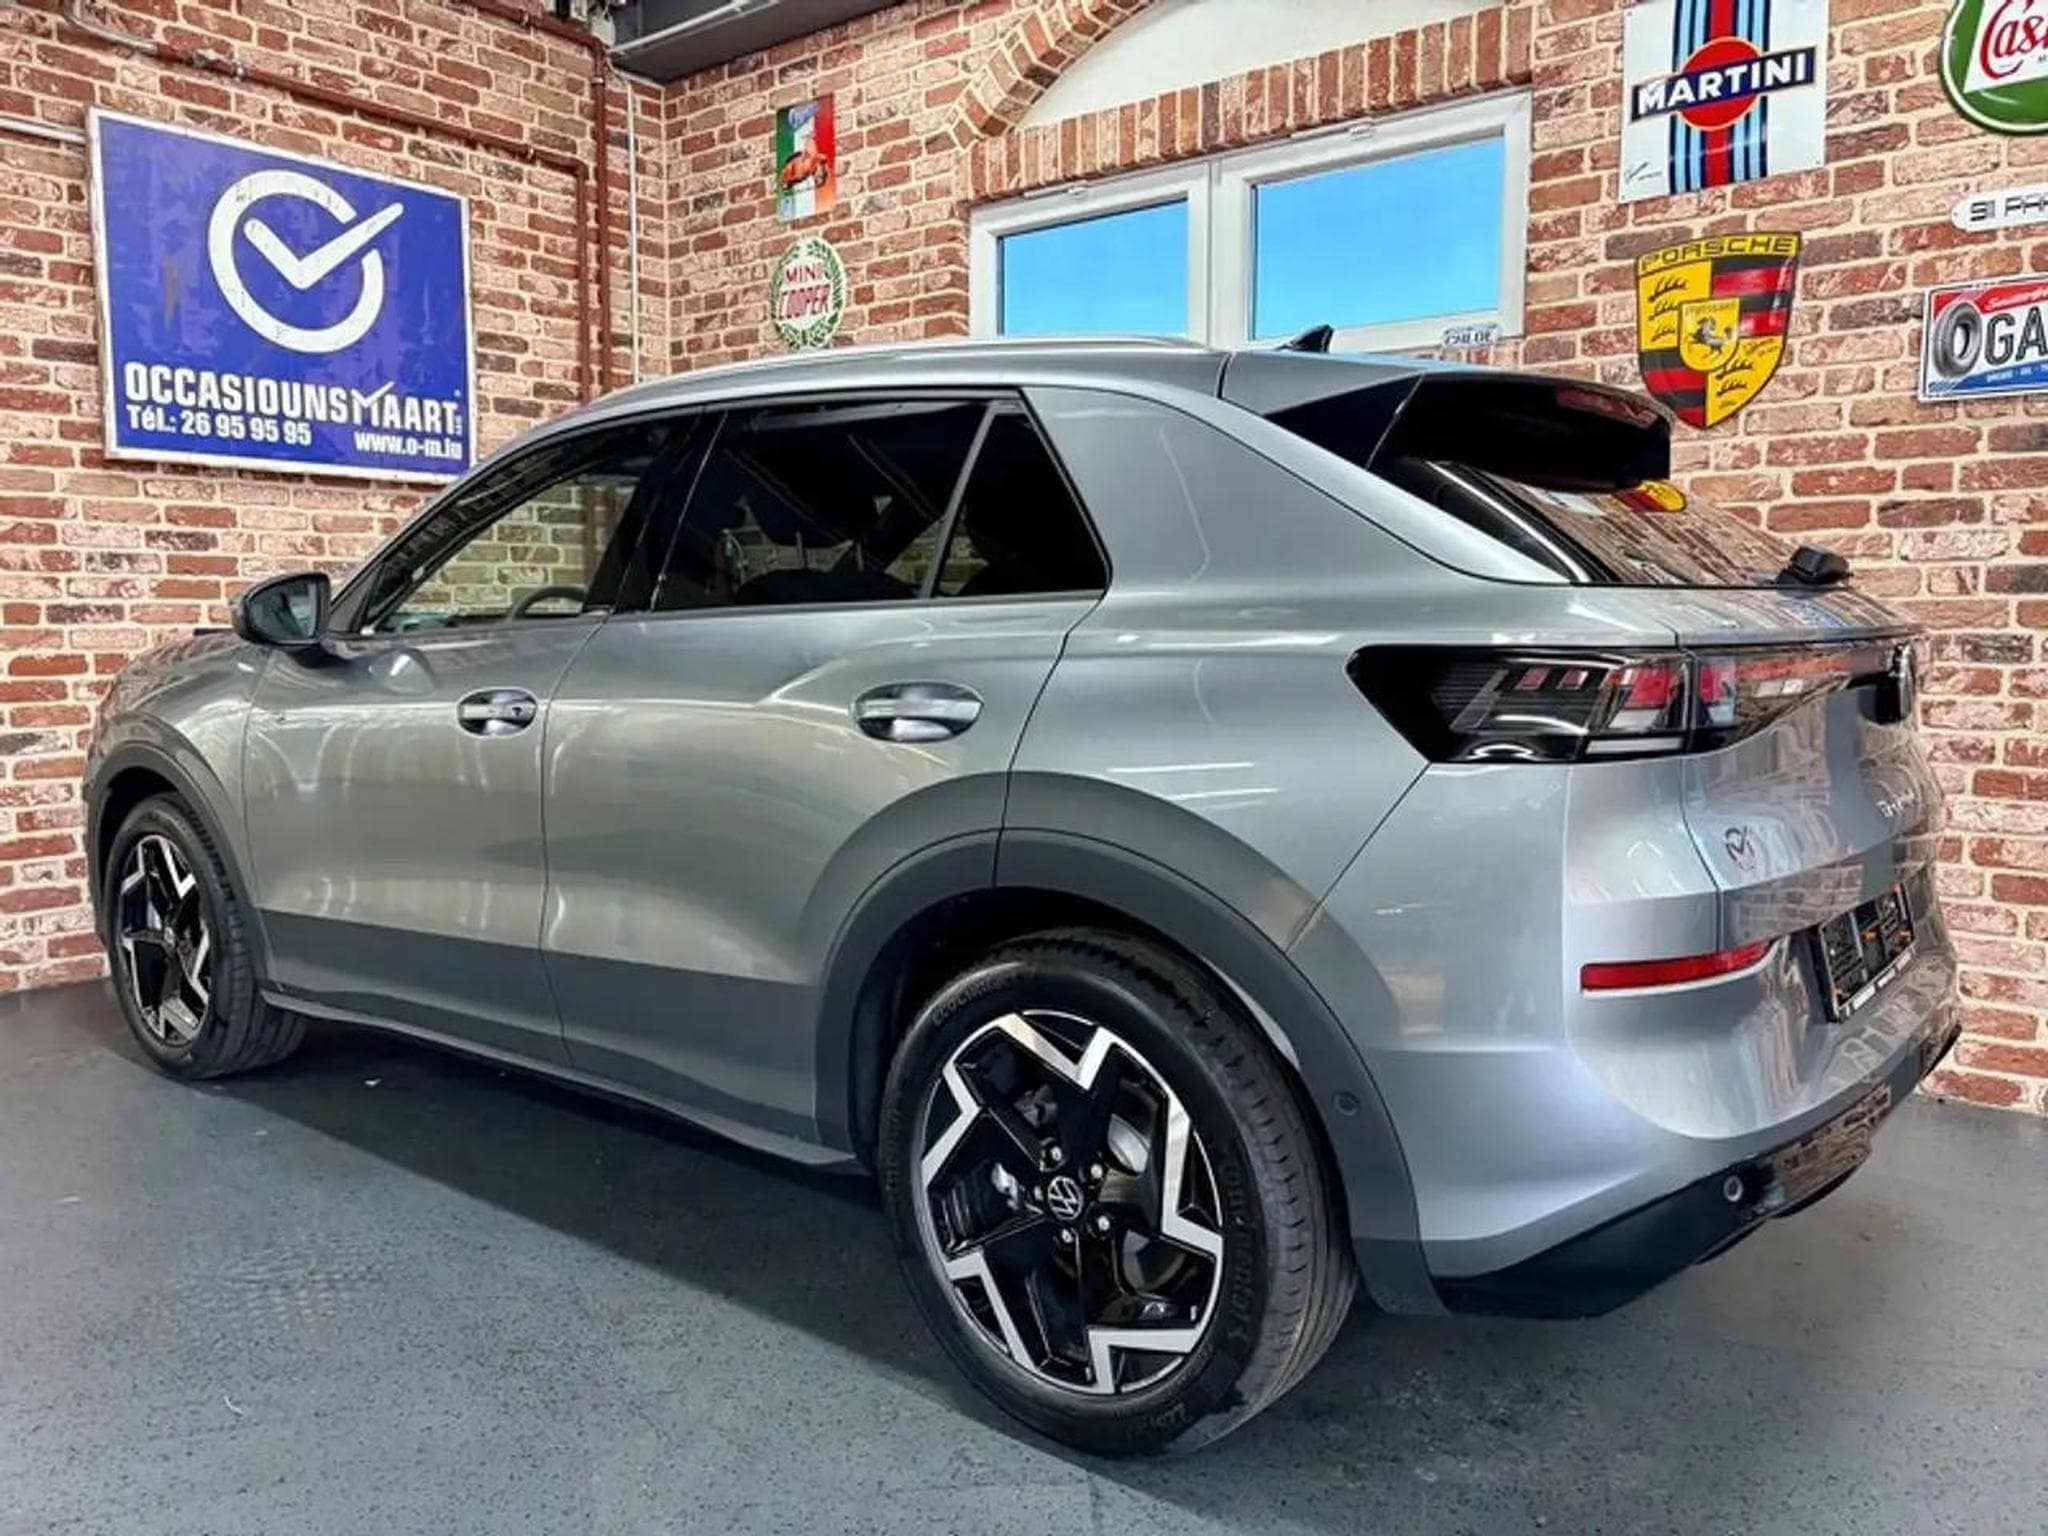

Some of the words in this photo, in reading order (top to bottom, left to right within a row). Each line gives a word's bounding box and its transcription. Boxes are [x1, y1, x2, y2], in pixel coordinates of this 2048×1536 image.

[1637, 53, 1806, 117] MARTINI
[1641, 236, 1794, 271] PORSCHE
[180, 410, 212, 435] 26
[215, 414, 246, 440] 95
[249, 417, 280, 443] 95
[283, 421, 313, 446] 95
[354, 432, 463, 460] www.o-m.lu
